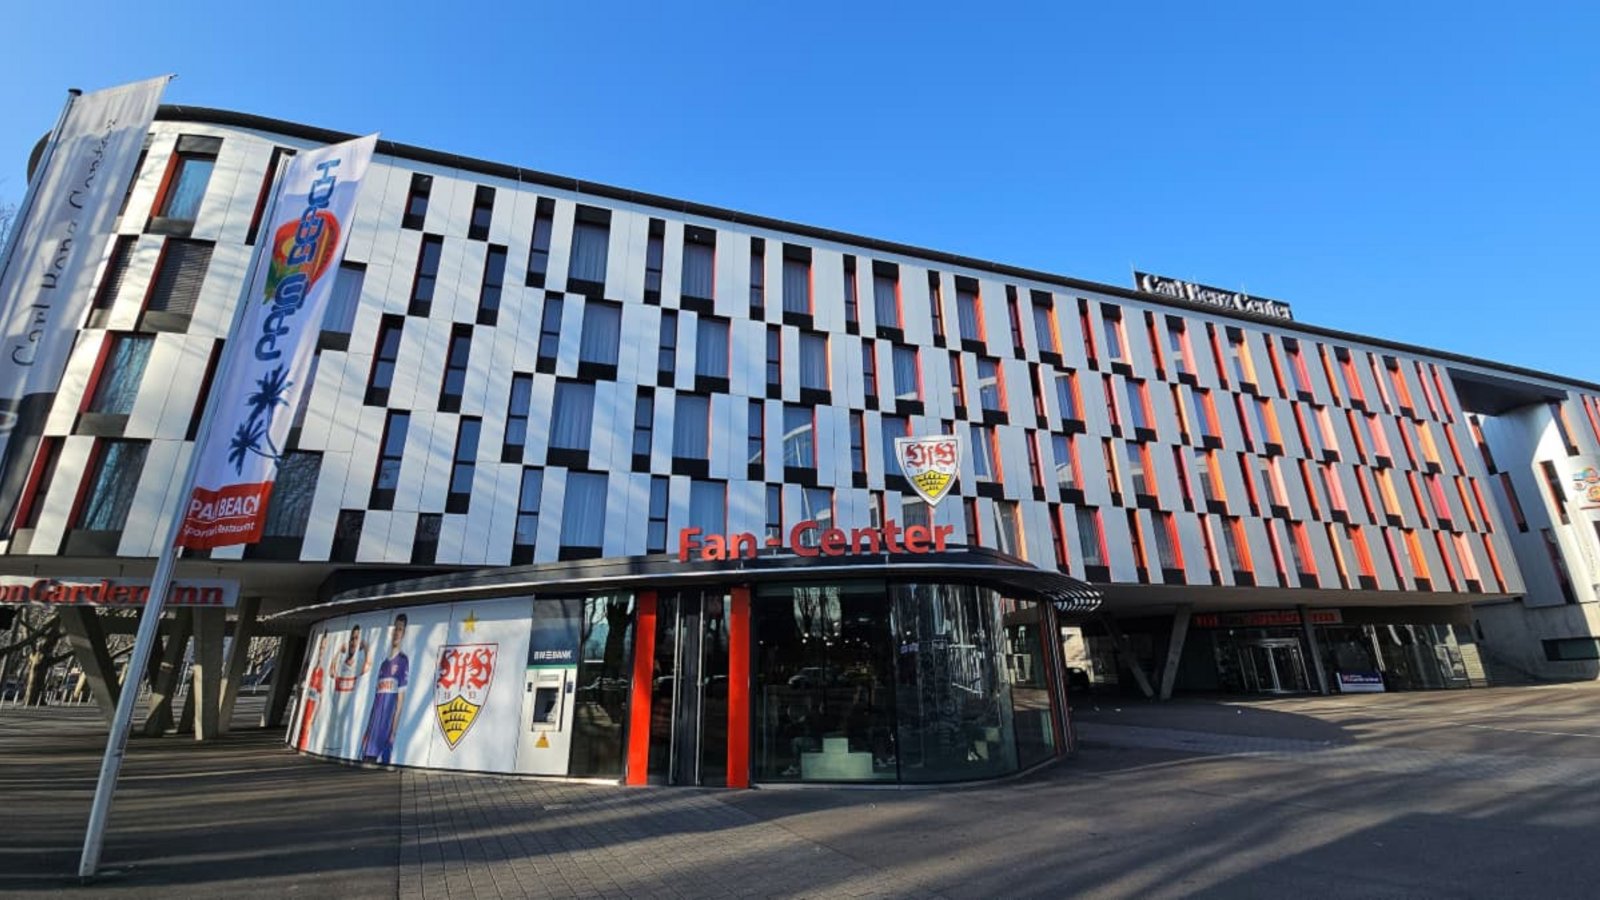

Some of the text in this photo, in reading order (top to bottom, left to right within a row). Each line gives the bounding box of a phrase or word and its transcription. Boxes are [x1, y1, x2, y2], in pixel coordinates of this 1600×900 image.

[286, 158, 341, 266] BEACH
[29, 579, 151, 604] Garden
[168, 582, 224, 604] nn
